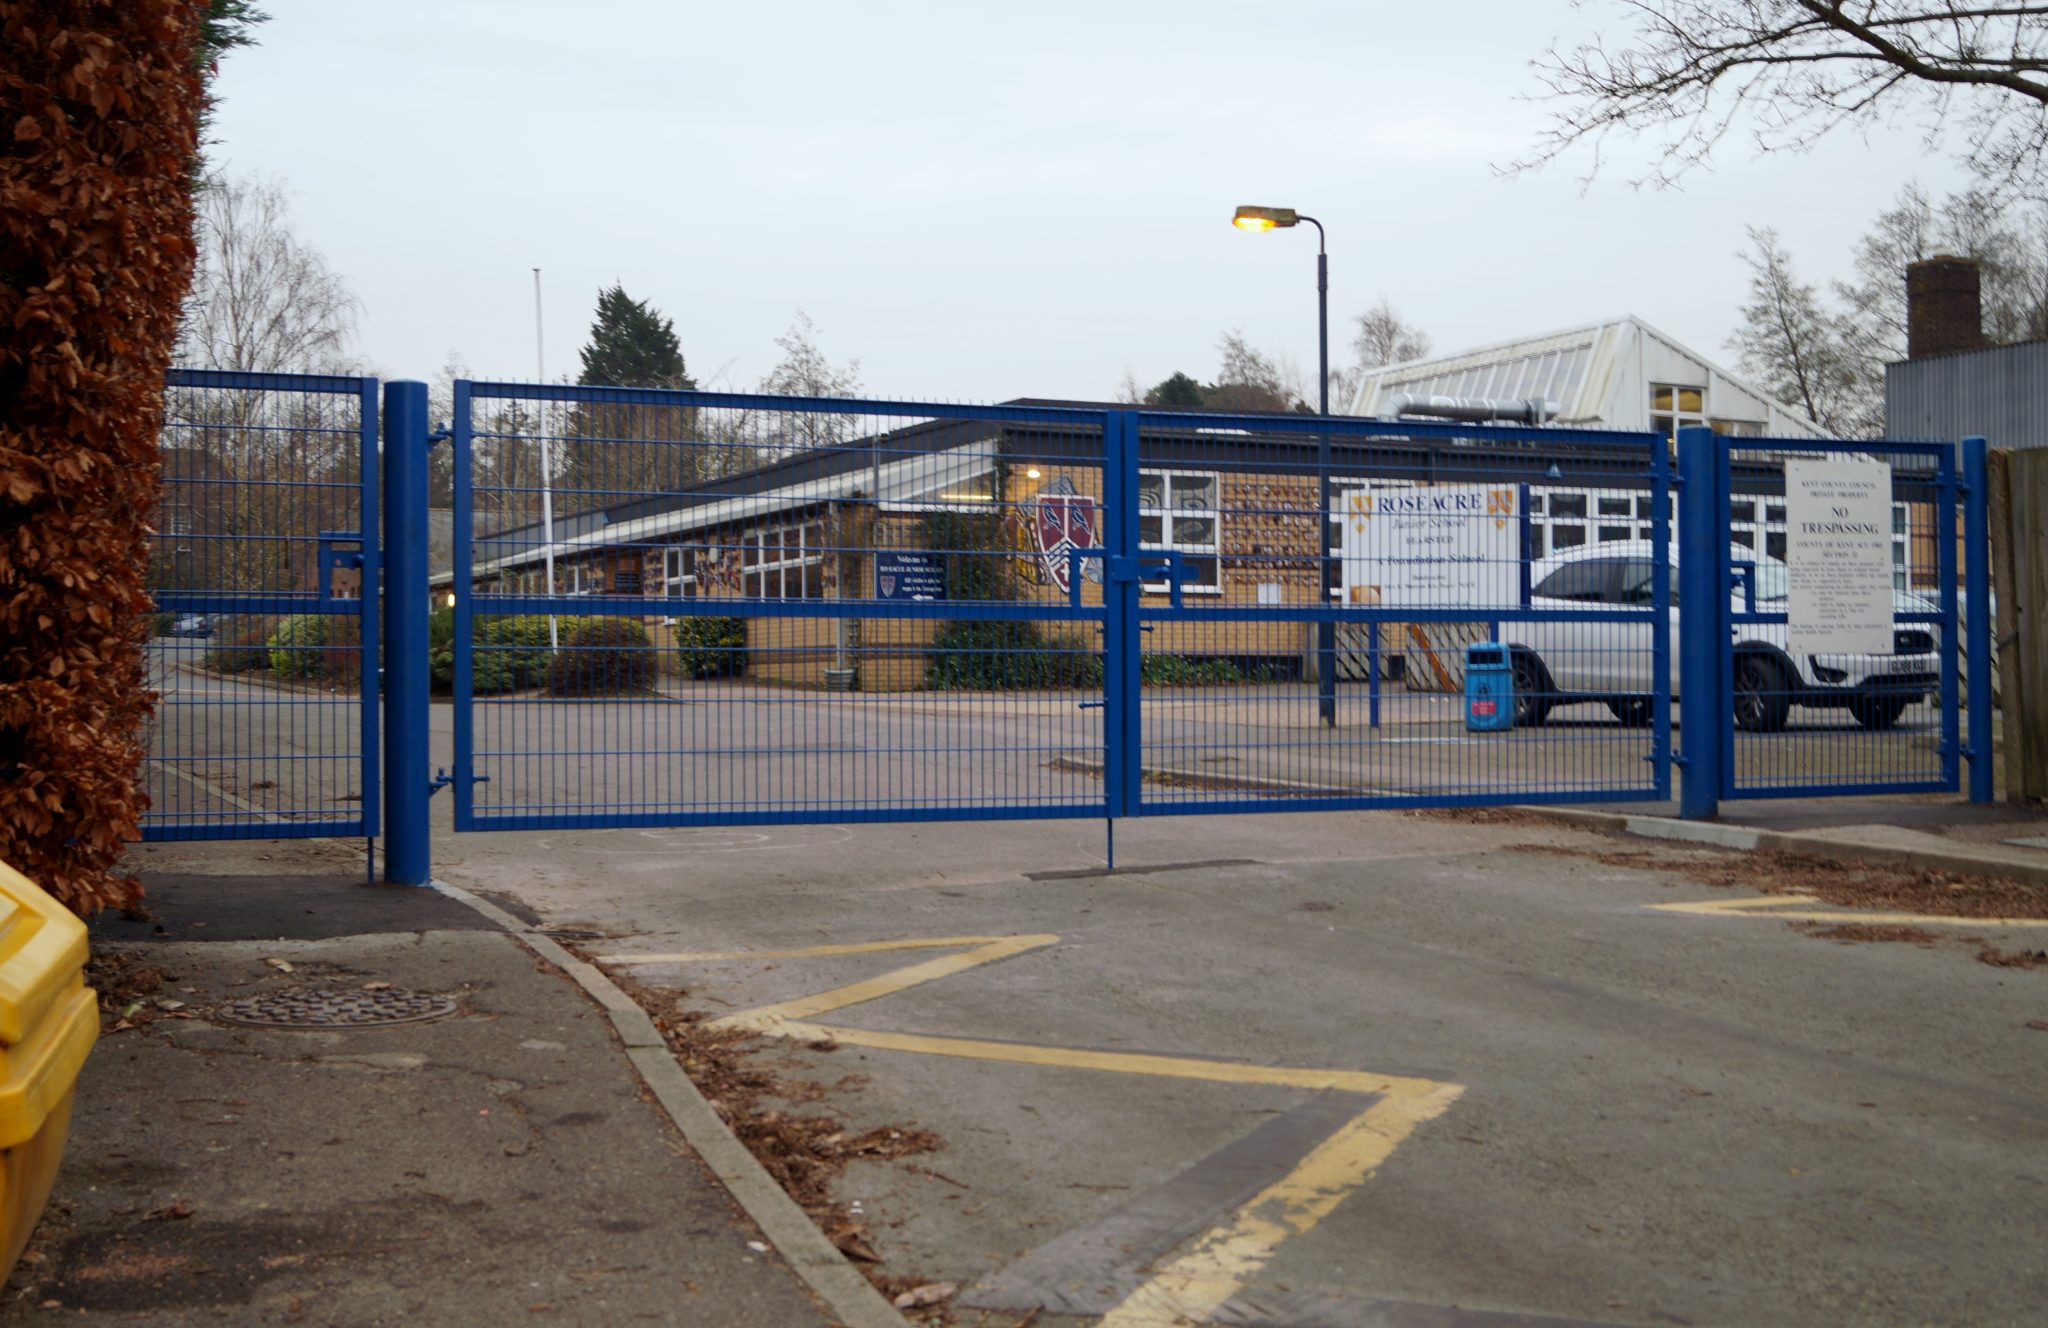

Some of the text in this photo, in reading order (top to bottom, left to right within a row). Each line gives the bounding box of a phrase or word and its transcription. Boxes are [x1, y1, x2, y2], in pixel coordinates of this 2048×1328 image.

[1821, 481, 1847, 489] COUNTY
[1849, 481, 1877, 489] COUNCIL
[1838, 491, 1869, 499] PROPERTY
[1377, 493, 1483, 513] ROSEACRE
[1832, 505, 1849, 518] NO
[1392, 517, 1466, 529] Junior School
[1800, 521, 1879, 534] TRESPASSING
[1406, 536, 1454, 545] BEARSTED
[1837, 541, 1854, 549] KENT
[1448, 553, 1485, 563] School
